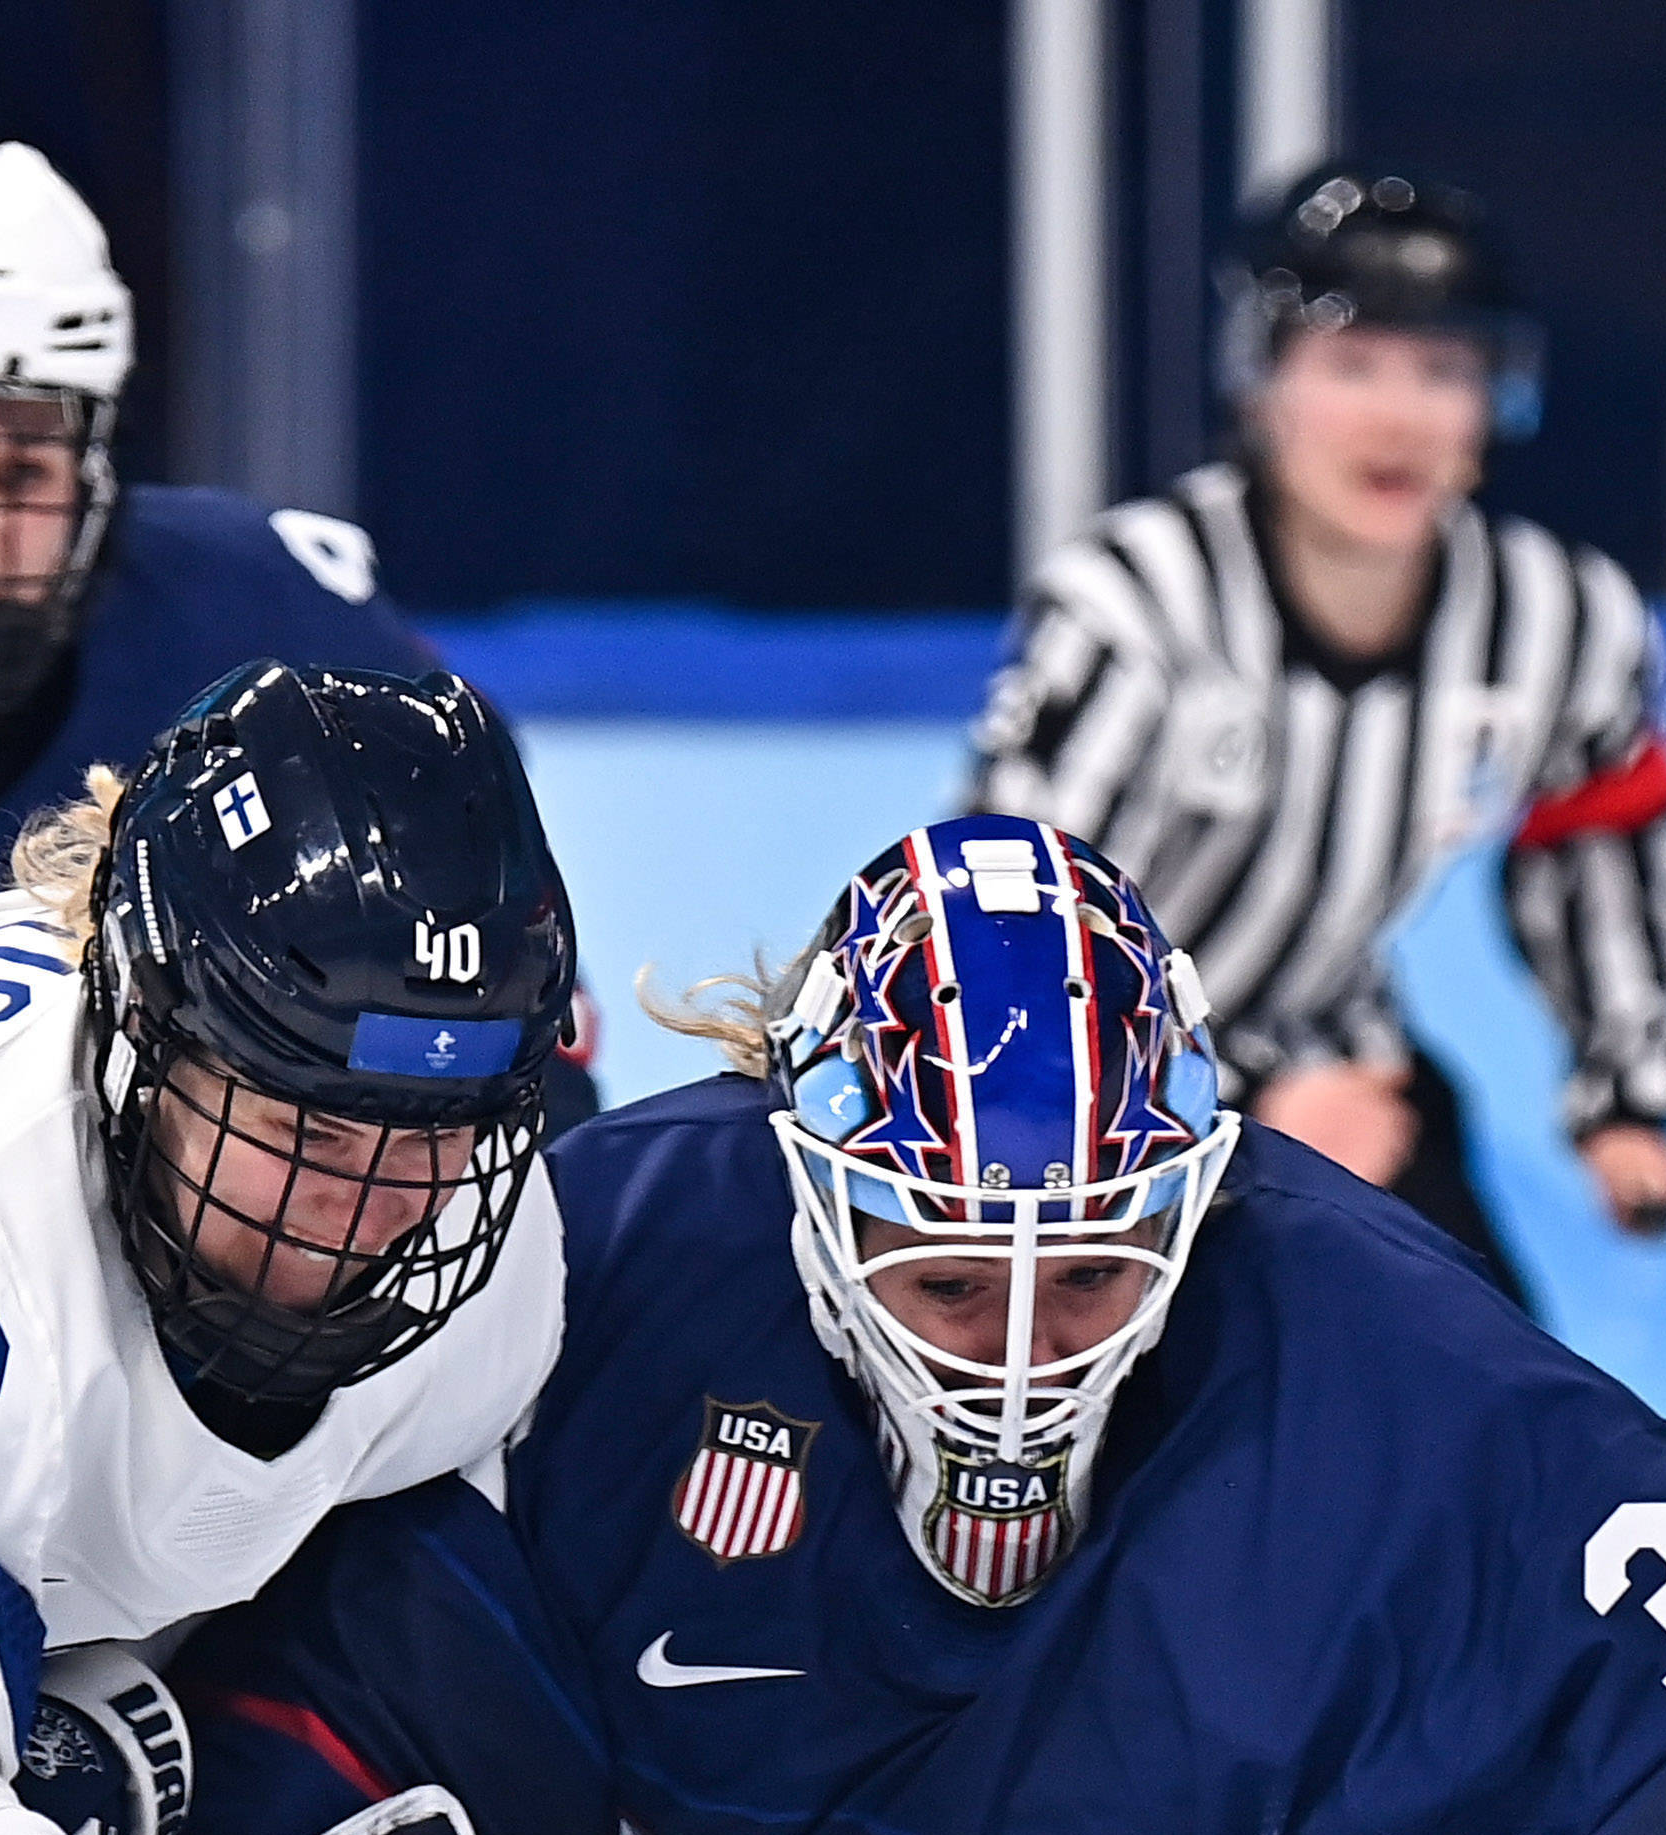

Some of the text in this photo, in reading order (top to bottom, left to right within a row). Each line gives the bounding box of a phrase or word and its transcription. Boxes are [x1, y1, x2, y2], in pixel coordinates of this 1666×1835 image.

[414, 921, 481, 984] 40
[718, 1413, 792, 1459] USA
[956, 1471, 1048, 1509] USA
